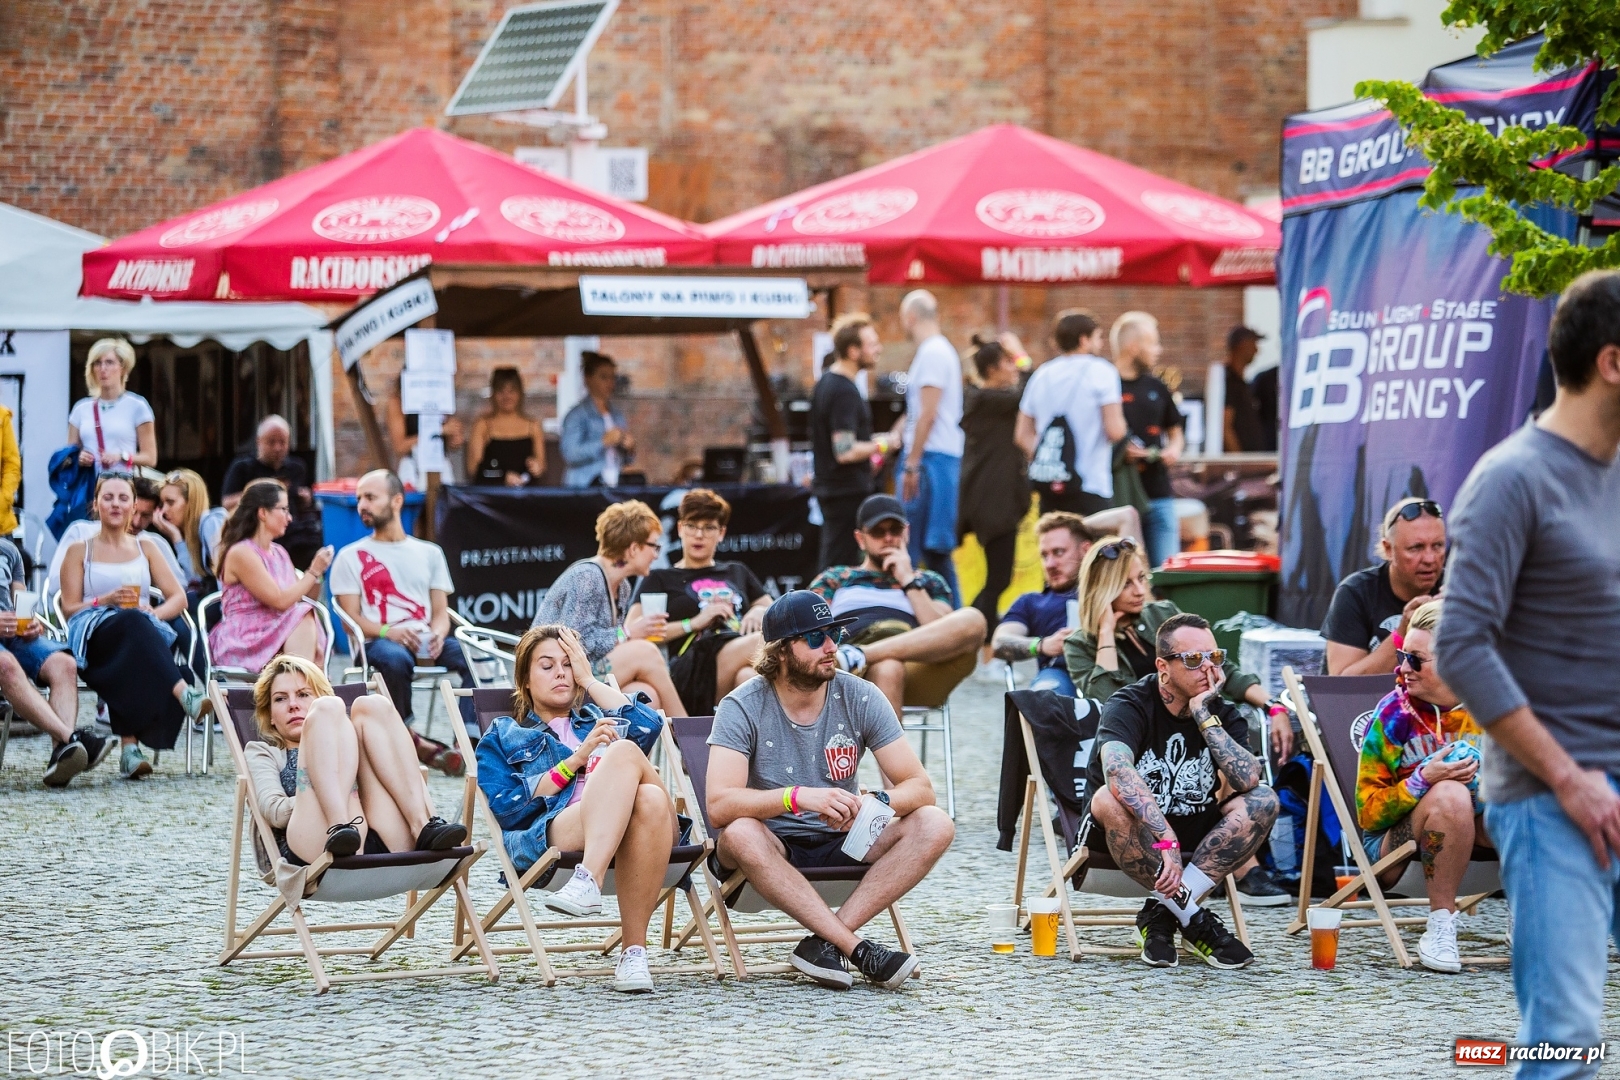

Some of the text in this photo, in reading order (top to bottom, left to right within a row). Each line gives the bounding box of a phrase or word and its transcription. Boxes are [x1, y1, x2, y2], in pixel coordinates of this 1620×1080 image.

[1299, 146, 1335, 184] BB
[1338, 130, 1415, 178] GROU
[1382, 303, 1425, 325] LIGHT
[1431, 298, 1498, 320] STAGE
[1368, 321, 1494, 375] GROUP
[460, 543, 567, 568] PRZYSTANEK
